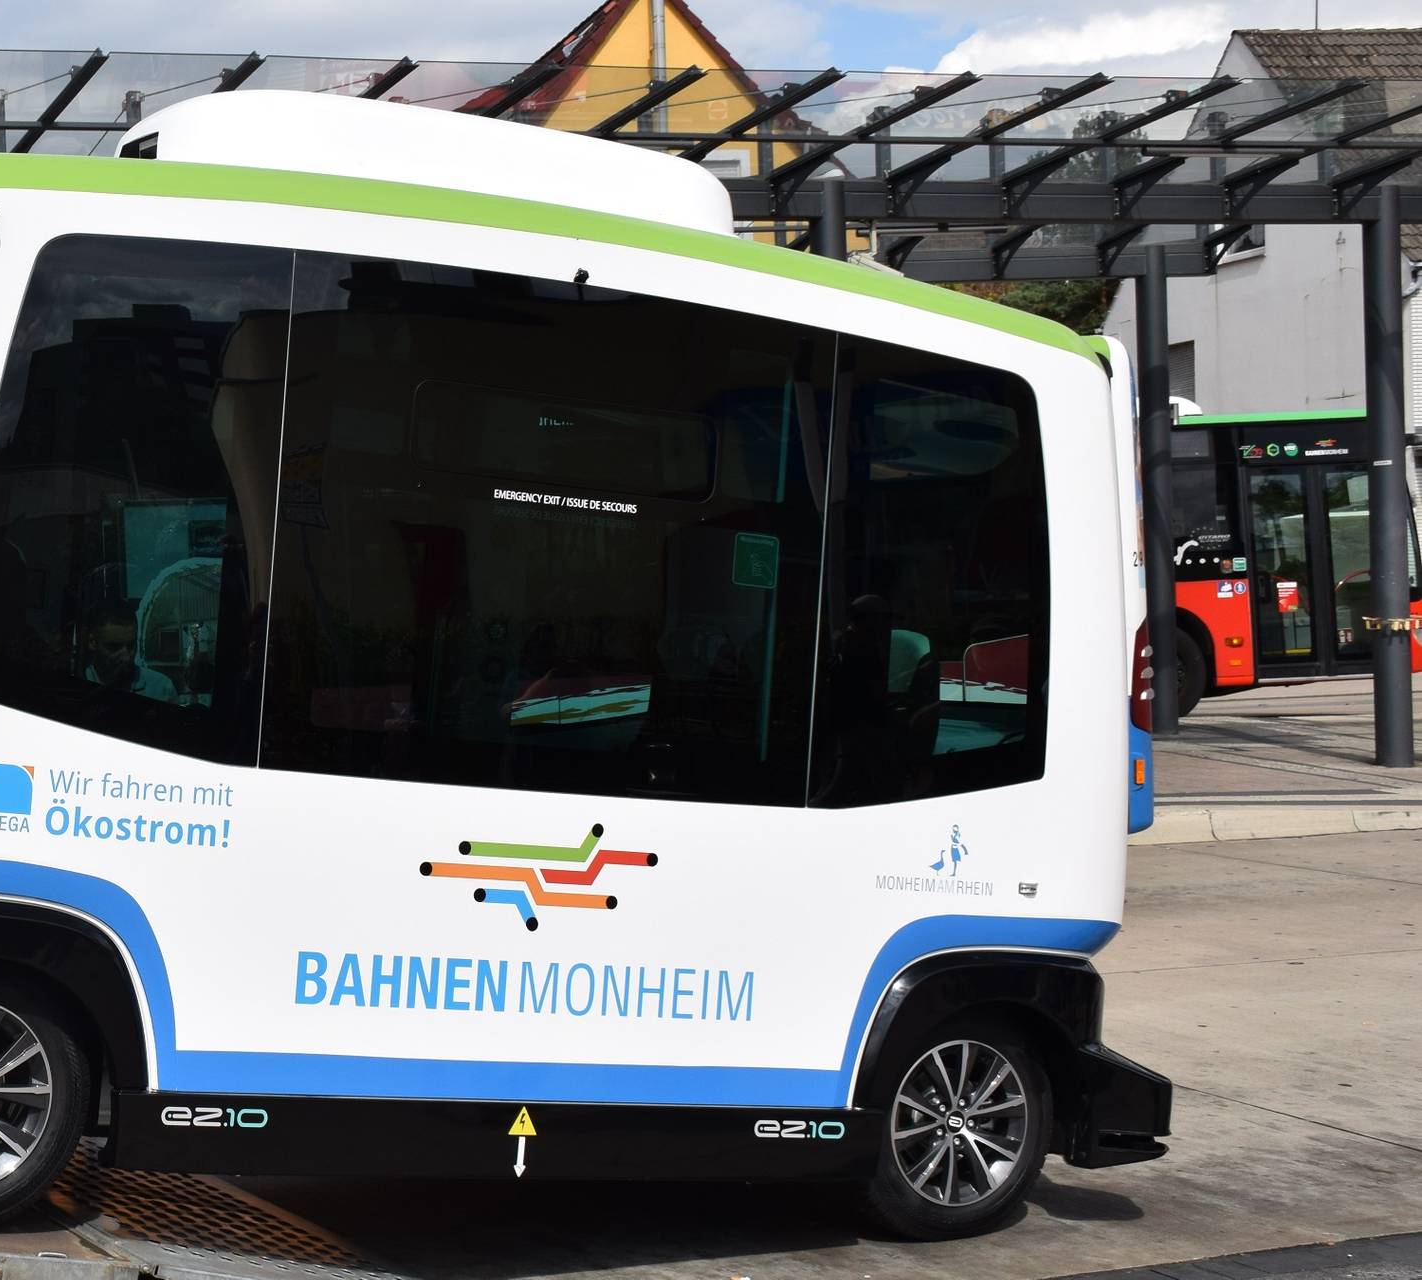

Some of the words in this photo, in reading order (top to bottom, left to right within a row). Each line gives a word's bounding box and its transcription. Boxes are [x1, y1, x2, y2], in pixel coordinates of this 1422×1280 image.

[494, 489, 543, 503] EMERGENCY
[543, 495, 562, 506] EXIT
[566, 497, 589, 509] ISSUE
[589, 500, 601, 511] DE
[601, 501, 638, 514] SECOURS
[49, 768, 93, 796] Wir
[101, 772, 183, 803] fahren
[192, 783, 234, 807] mit
[45, 798, 231, 848] Ökostrom!
